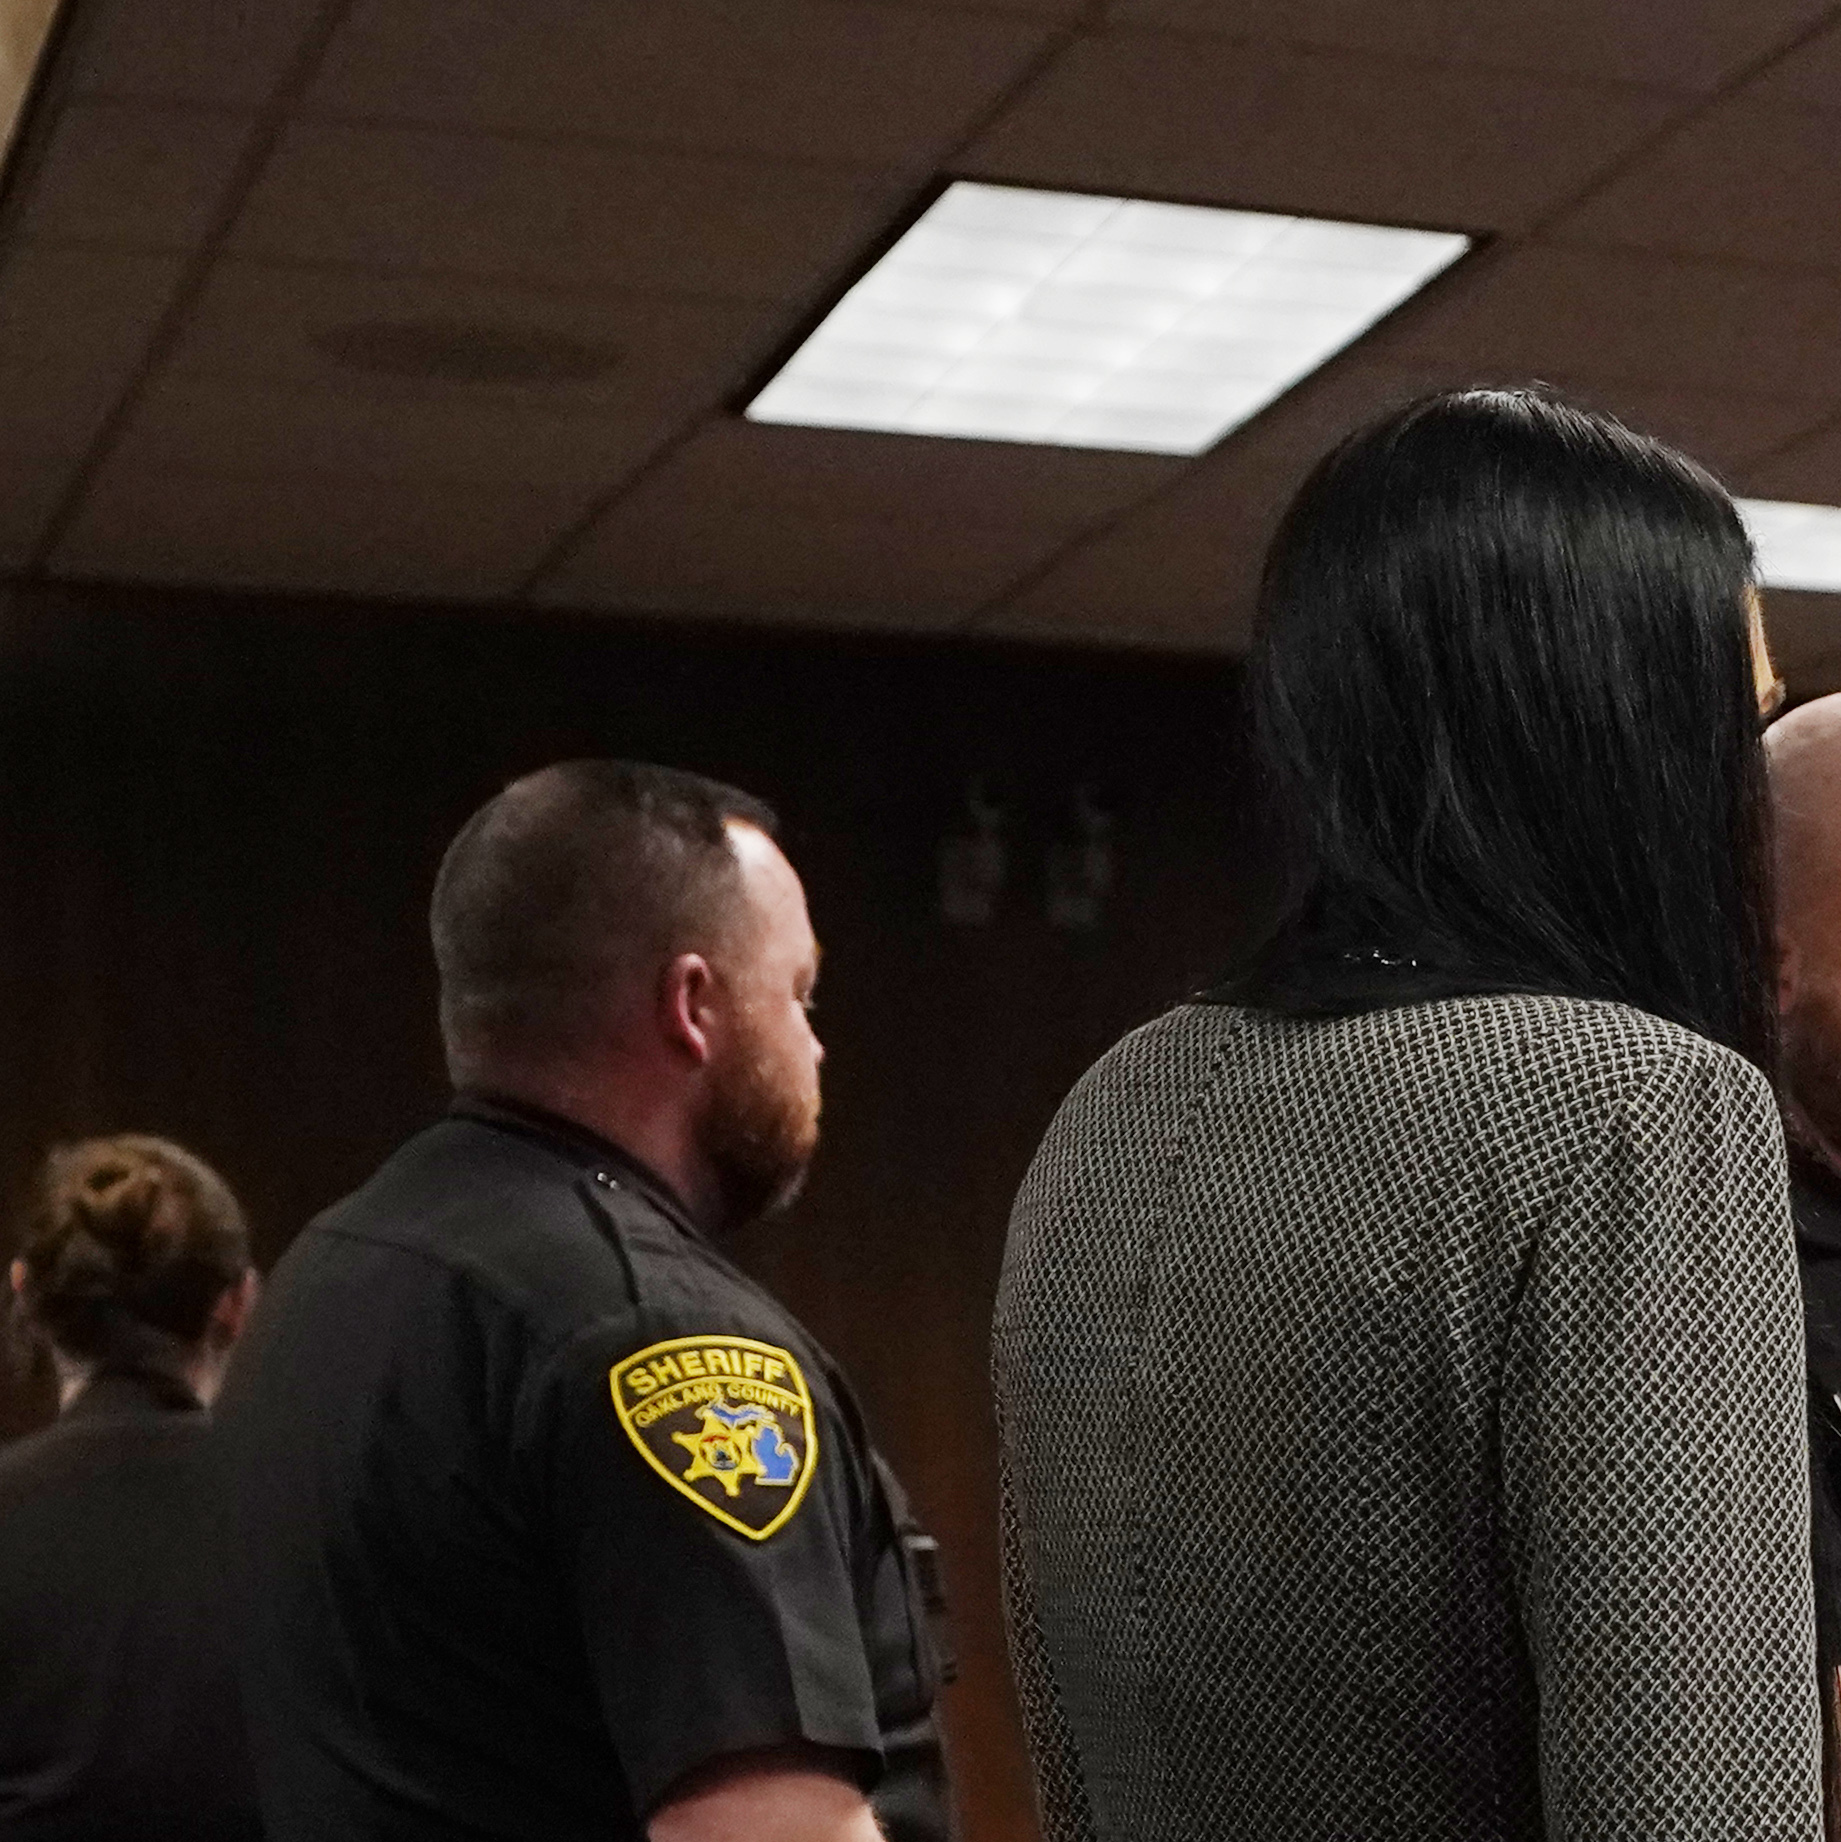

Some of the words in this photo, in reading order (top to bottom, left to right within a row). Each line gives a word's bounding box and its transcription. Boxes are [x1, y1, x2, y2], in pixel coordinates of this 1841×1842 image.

[626, 1348, 787, 1396] SHERIFF
[634, 1382, 722, 1428] OAKLAND
[727, 1382, 802, 1417] COUNTY
